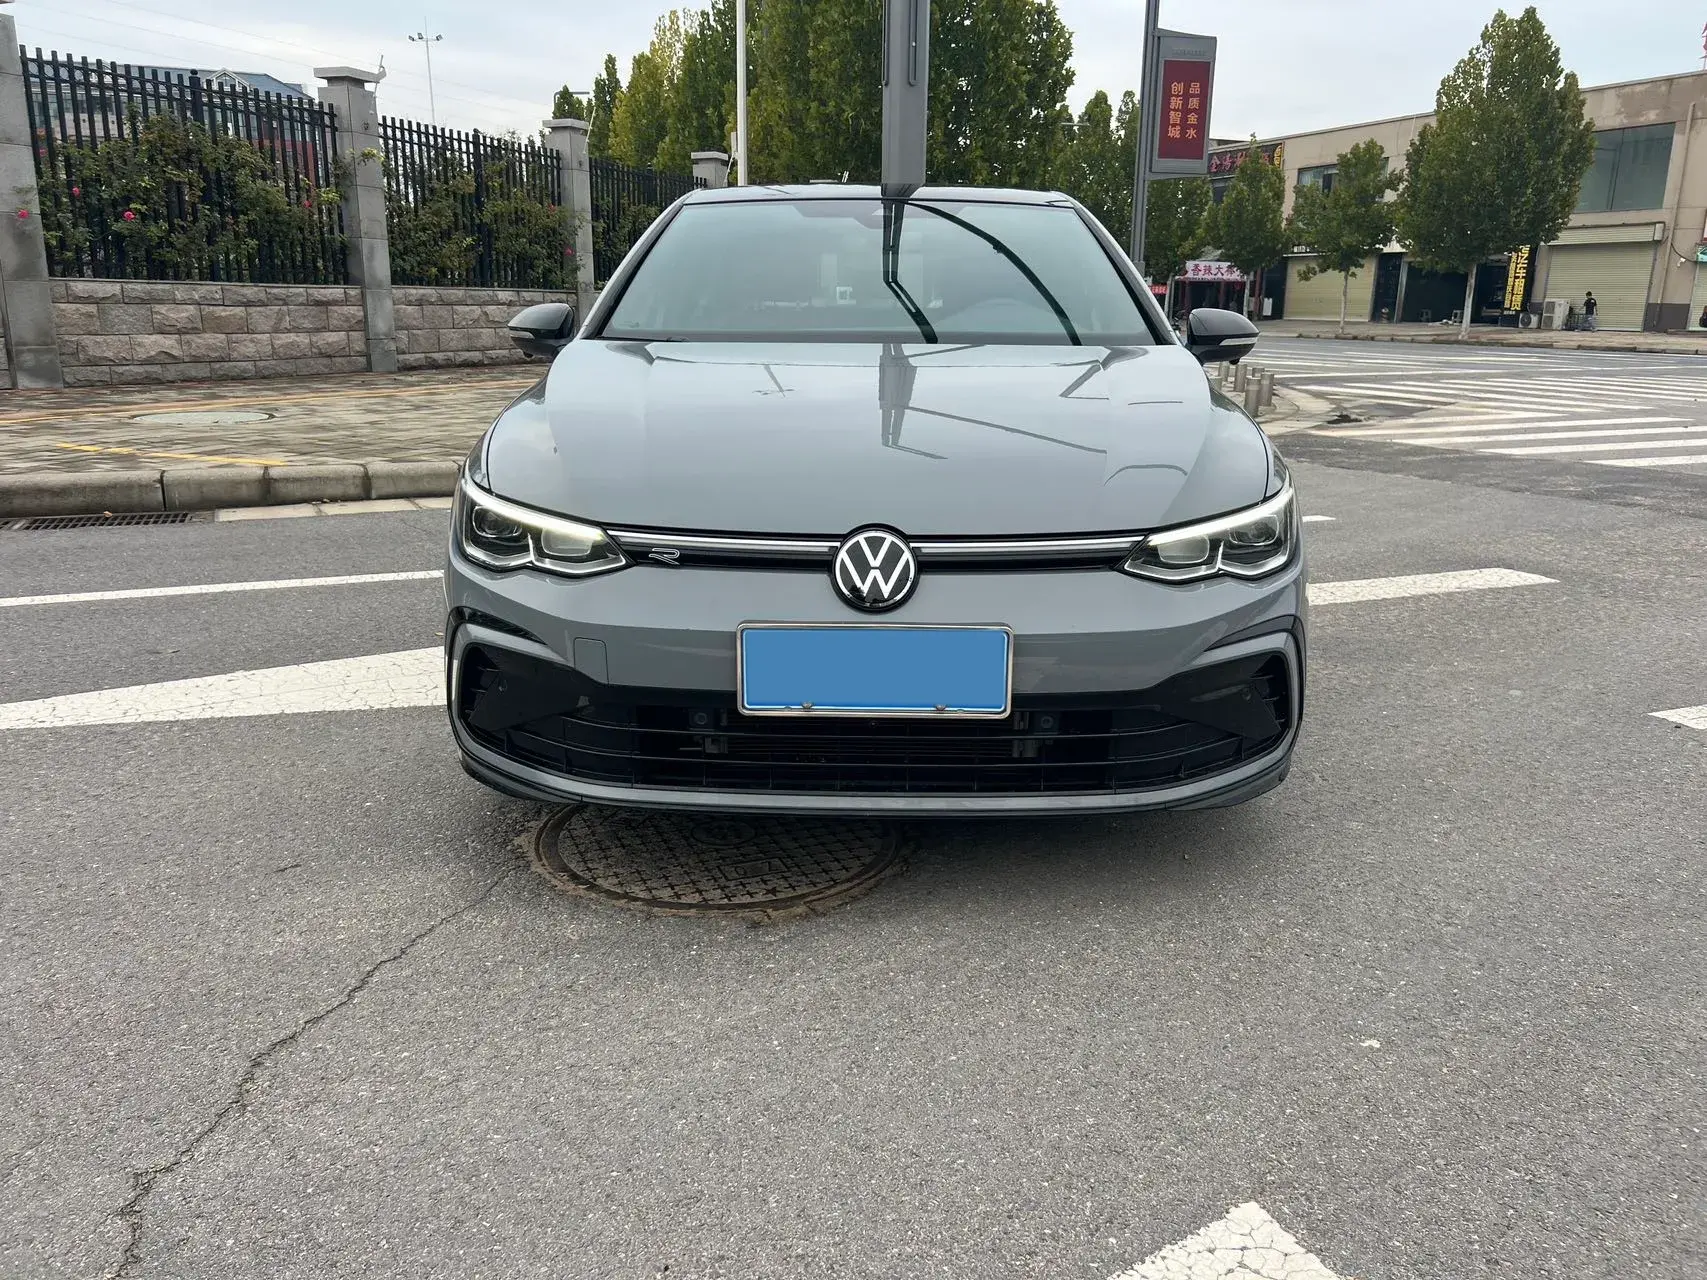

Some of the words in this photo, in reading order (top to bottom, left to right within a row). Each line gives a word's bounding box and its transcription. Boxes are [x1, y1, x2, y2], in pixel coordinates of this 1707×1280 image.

[1167, 82, 1183, 138] 创新智城
[1185, 82, 1200, 139] 品质金水
